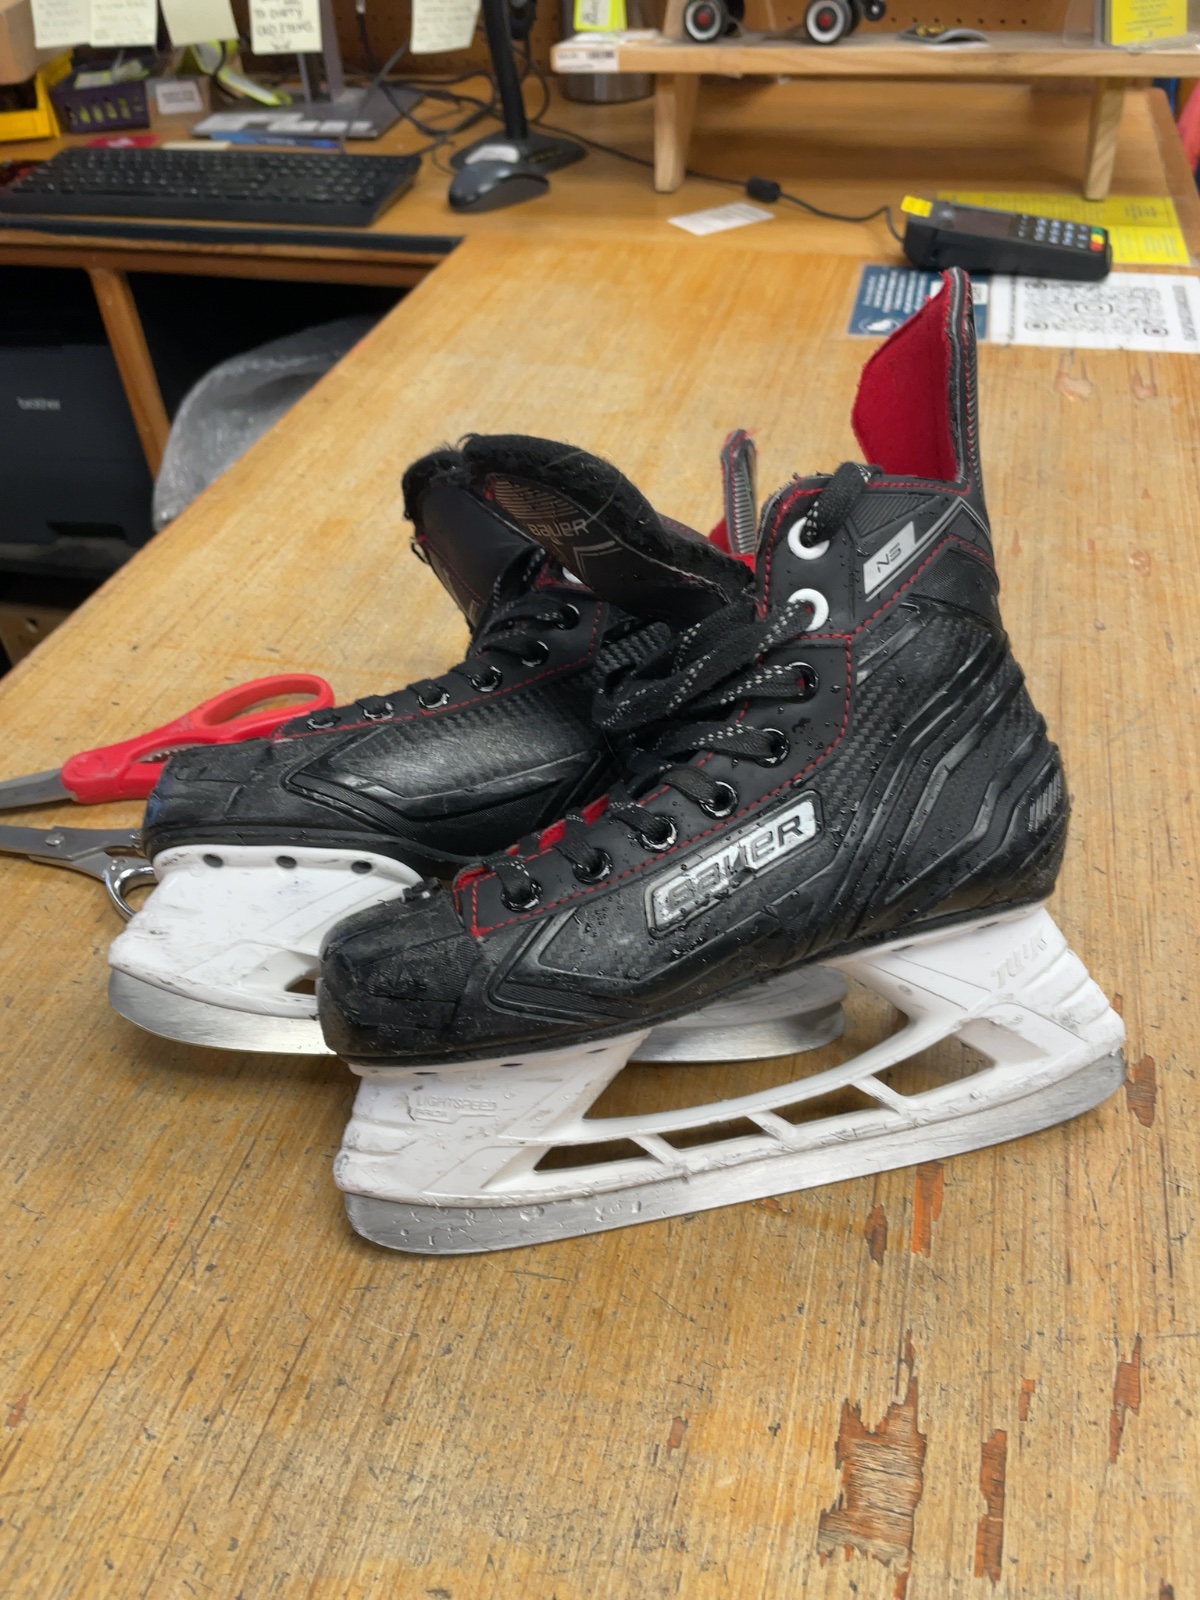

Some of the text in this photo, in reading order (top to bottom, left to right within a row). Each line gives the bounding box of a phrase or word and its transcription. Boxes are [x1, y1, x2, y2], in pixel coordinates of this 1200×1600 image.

[527, 517, 590, 538] BAUER
[875, 542, 902, 574] NS
[415, 1094, 498, 1112] LIGHTSPEED
